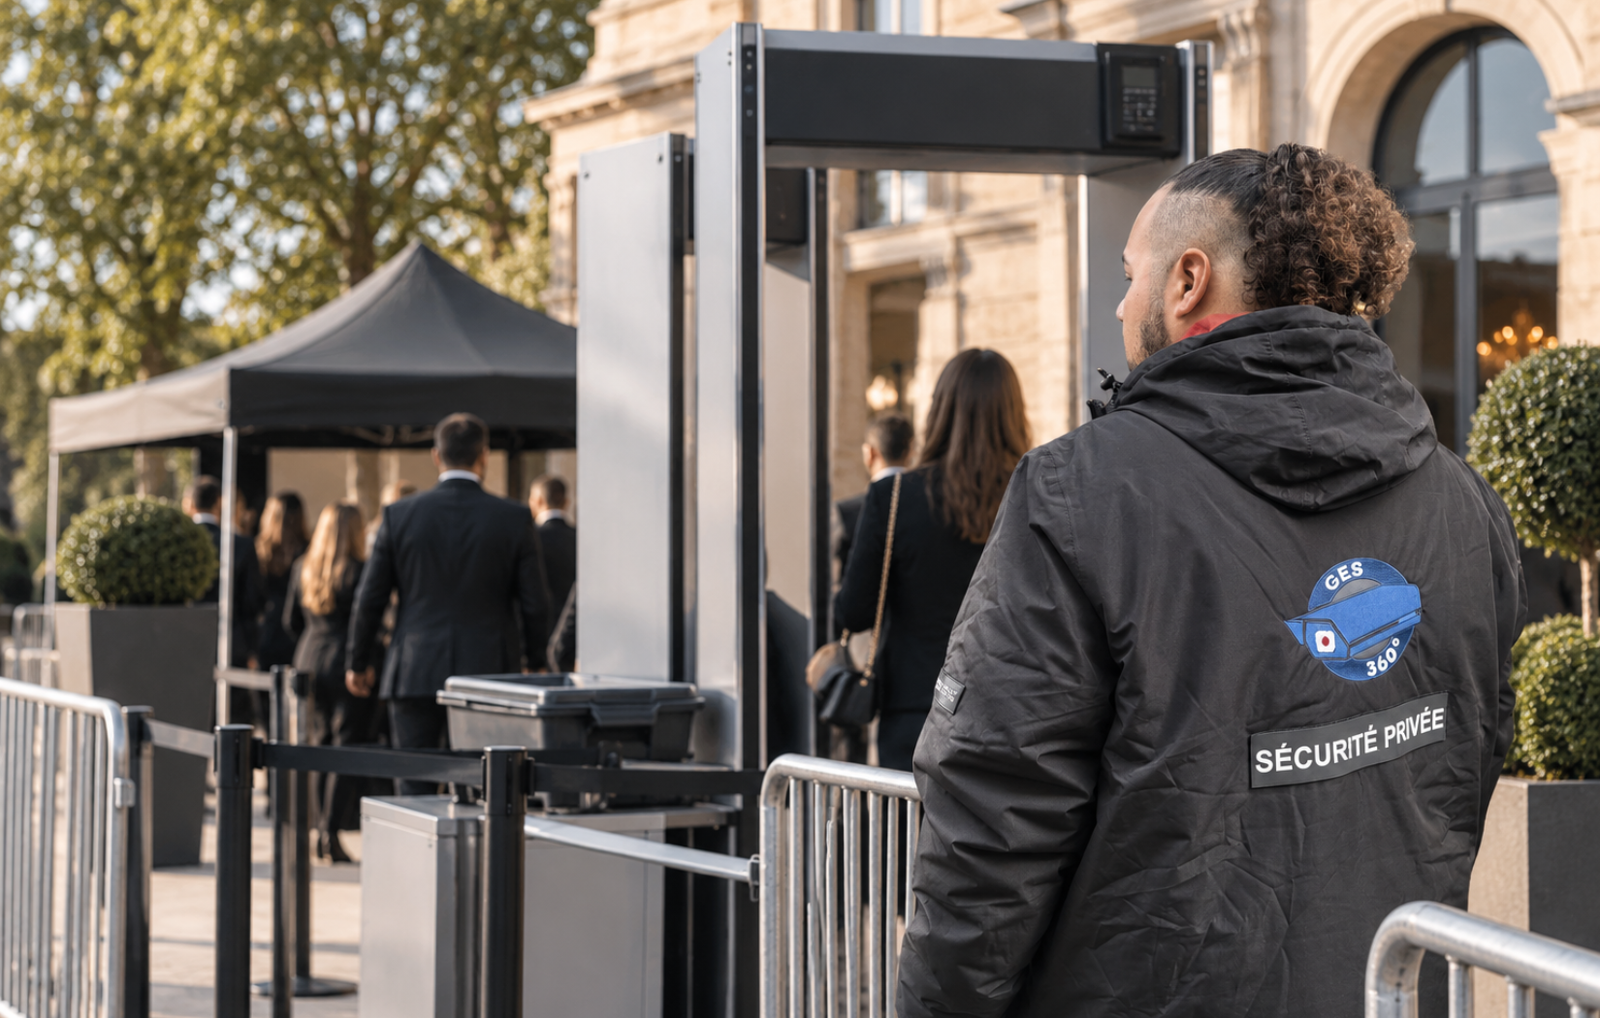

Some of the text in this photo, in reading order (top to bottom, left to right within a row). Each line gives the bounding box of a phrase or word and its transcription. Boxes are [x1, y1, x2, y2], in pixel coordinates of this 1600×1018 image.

[1325, 561, 1364, 590] GES
[1366, 637, 1400, 677] 360°
[1255, 706, 1445, 773] SÉCURITÉ PRIVÉE
